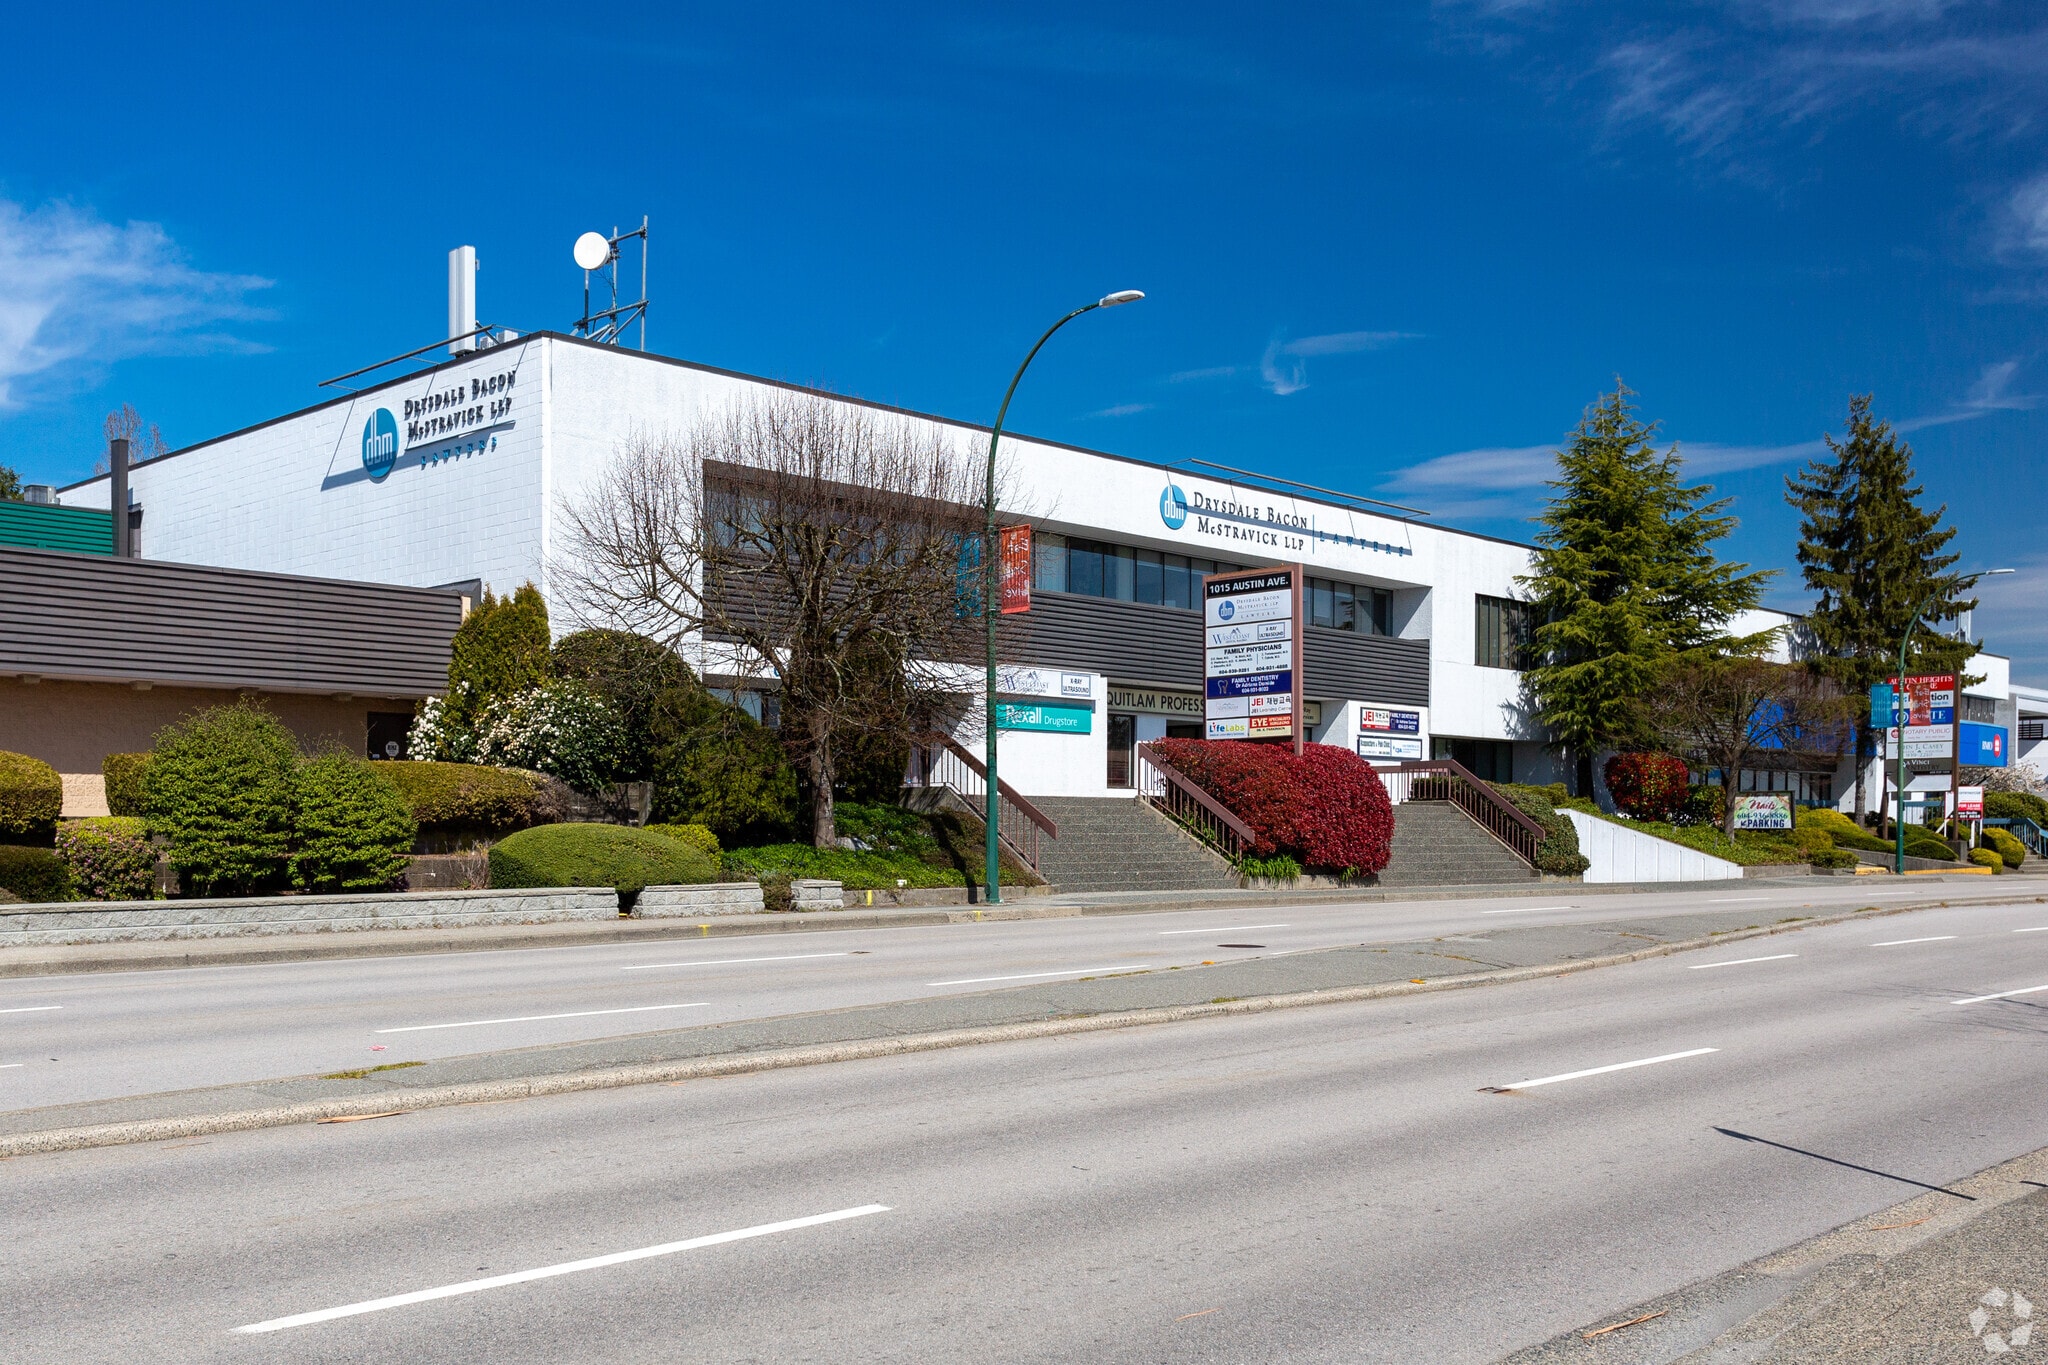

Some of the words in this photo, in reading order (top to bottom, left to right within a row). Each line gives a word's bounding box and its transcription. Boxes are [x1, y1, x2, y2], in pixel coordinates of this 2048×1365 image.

[404, 386, 465, 418] DRYSDALE
[472, 370, 517, 396] BACON
[490, 396, 513, 416] LLP
[366, 409, 393, 466] dbm
[421, 436, 498, 465] LAWYERS
[1164, 485, 1184, 521] dbm
[1194, 491, 1259, 520] DRYSDALE
[1267, 506, 1308, 529] BACON
[1284, 536, 1304, 551] LLP
[1320, 529, 1405, 557] LAWYERS
[1209, 583, 1230, 594] 1015
[1232, 579, 1265, 591] AUSTIN
[1267, 576, 1289, 587] AVE.
[1224, 647, 1246, 655] FAMILY
[1246, 643, 1282, 653] PHYSICIANS
[1920, 675, 1953, 683] HEIGHTS
[1251, 697, 1264, 707] JEI
[1044, 715, 1078, 728] Drugstore
[1251, 717, 1268, 728] EYE
[1363, 711, 1375, 721] JEI
[1209, 722, 1245, 733] LifeLabs
[1748, 800, 1777, 810] Nails
[1747, 819, 1785, 828] PARKING
